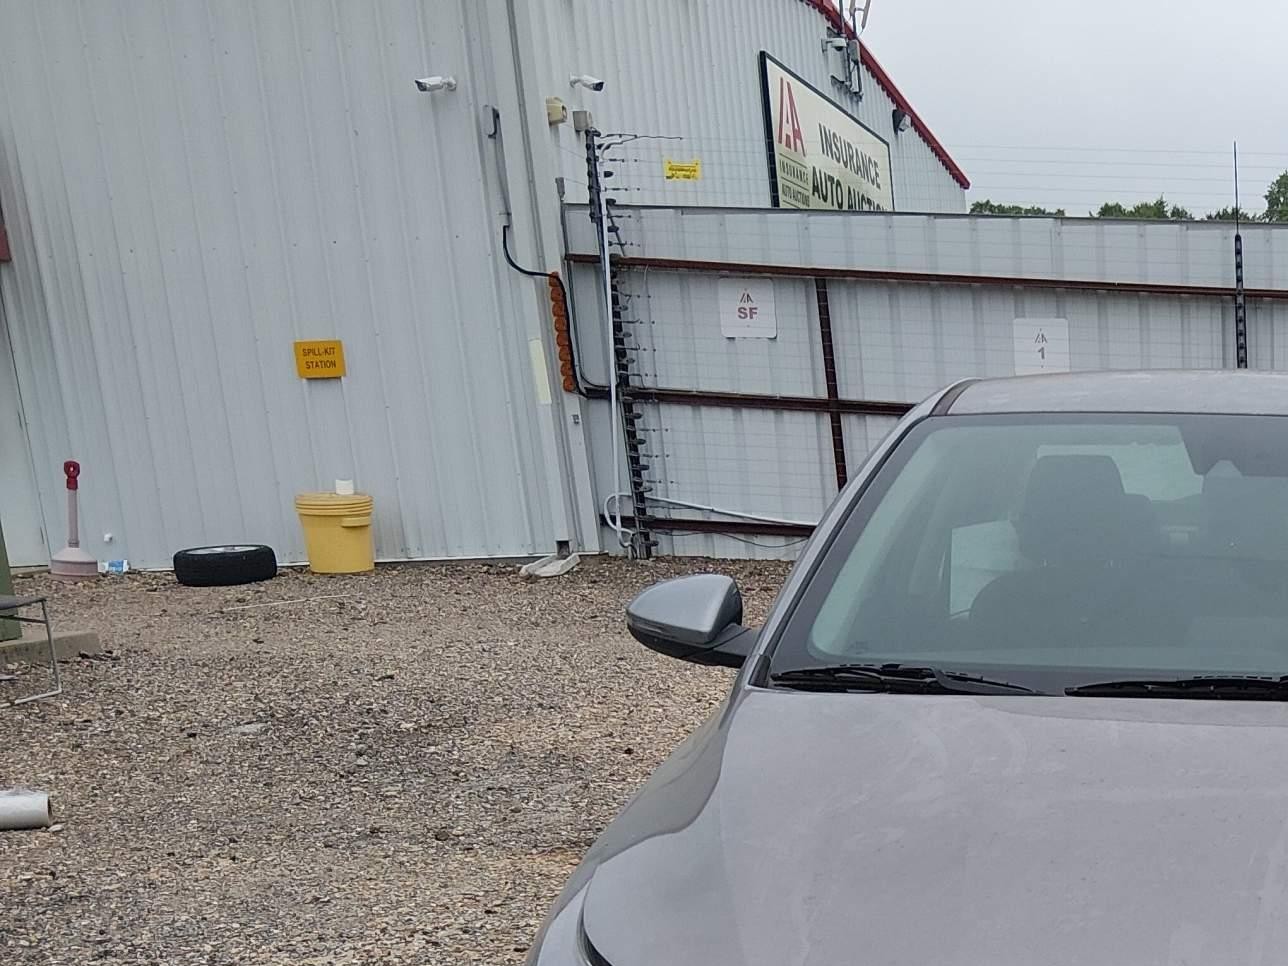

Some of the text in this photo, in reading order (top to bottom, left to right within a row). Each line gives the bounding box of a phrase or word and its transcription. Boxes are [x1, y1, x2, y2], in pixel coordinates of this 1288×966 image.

[818, 122, 882, 190] INSURANCE
[811, 165, 844, 210] AUTO
[737, 306, 758, 320] SF
[1037, 346, 1045, 360] 1
[305, 360, 336, 369] STATION
